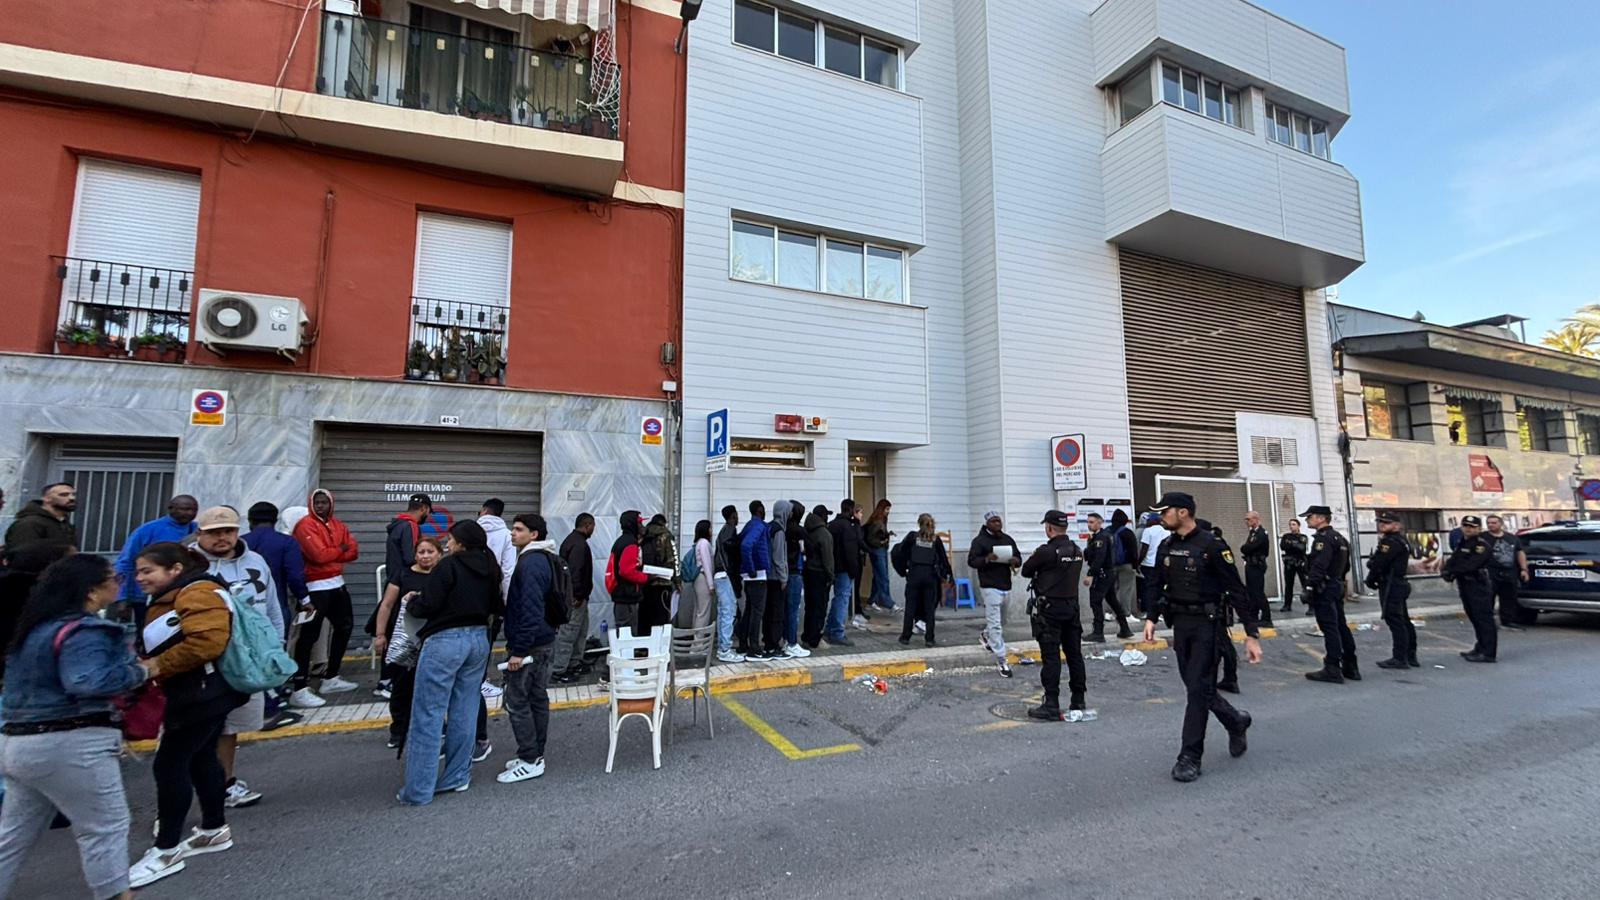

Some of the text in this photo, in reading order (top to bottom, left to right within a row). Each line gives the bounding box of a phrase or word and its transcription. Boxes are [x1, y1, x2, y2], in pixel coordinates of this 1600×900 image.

[271, 323, 287, 332] LG
[710, 416, 723, 452] P
[427, 494, 447, 503] RUA
